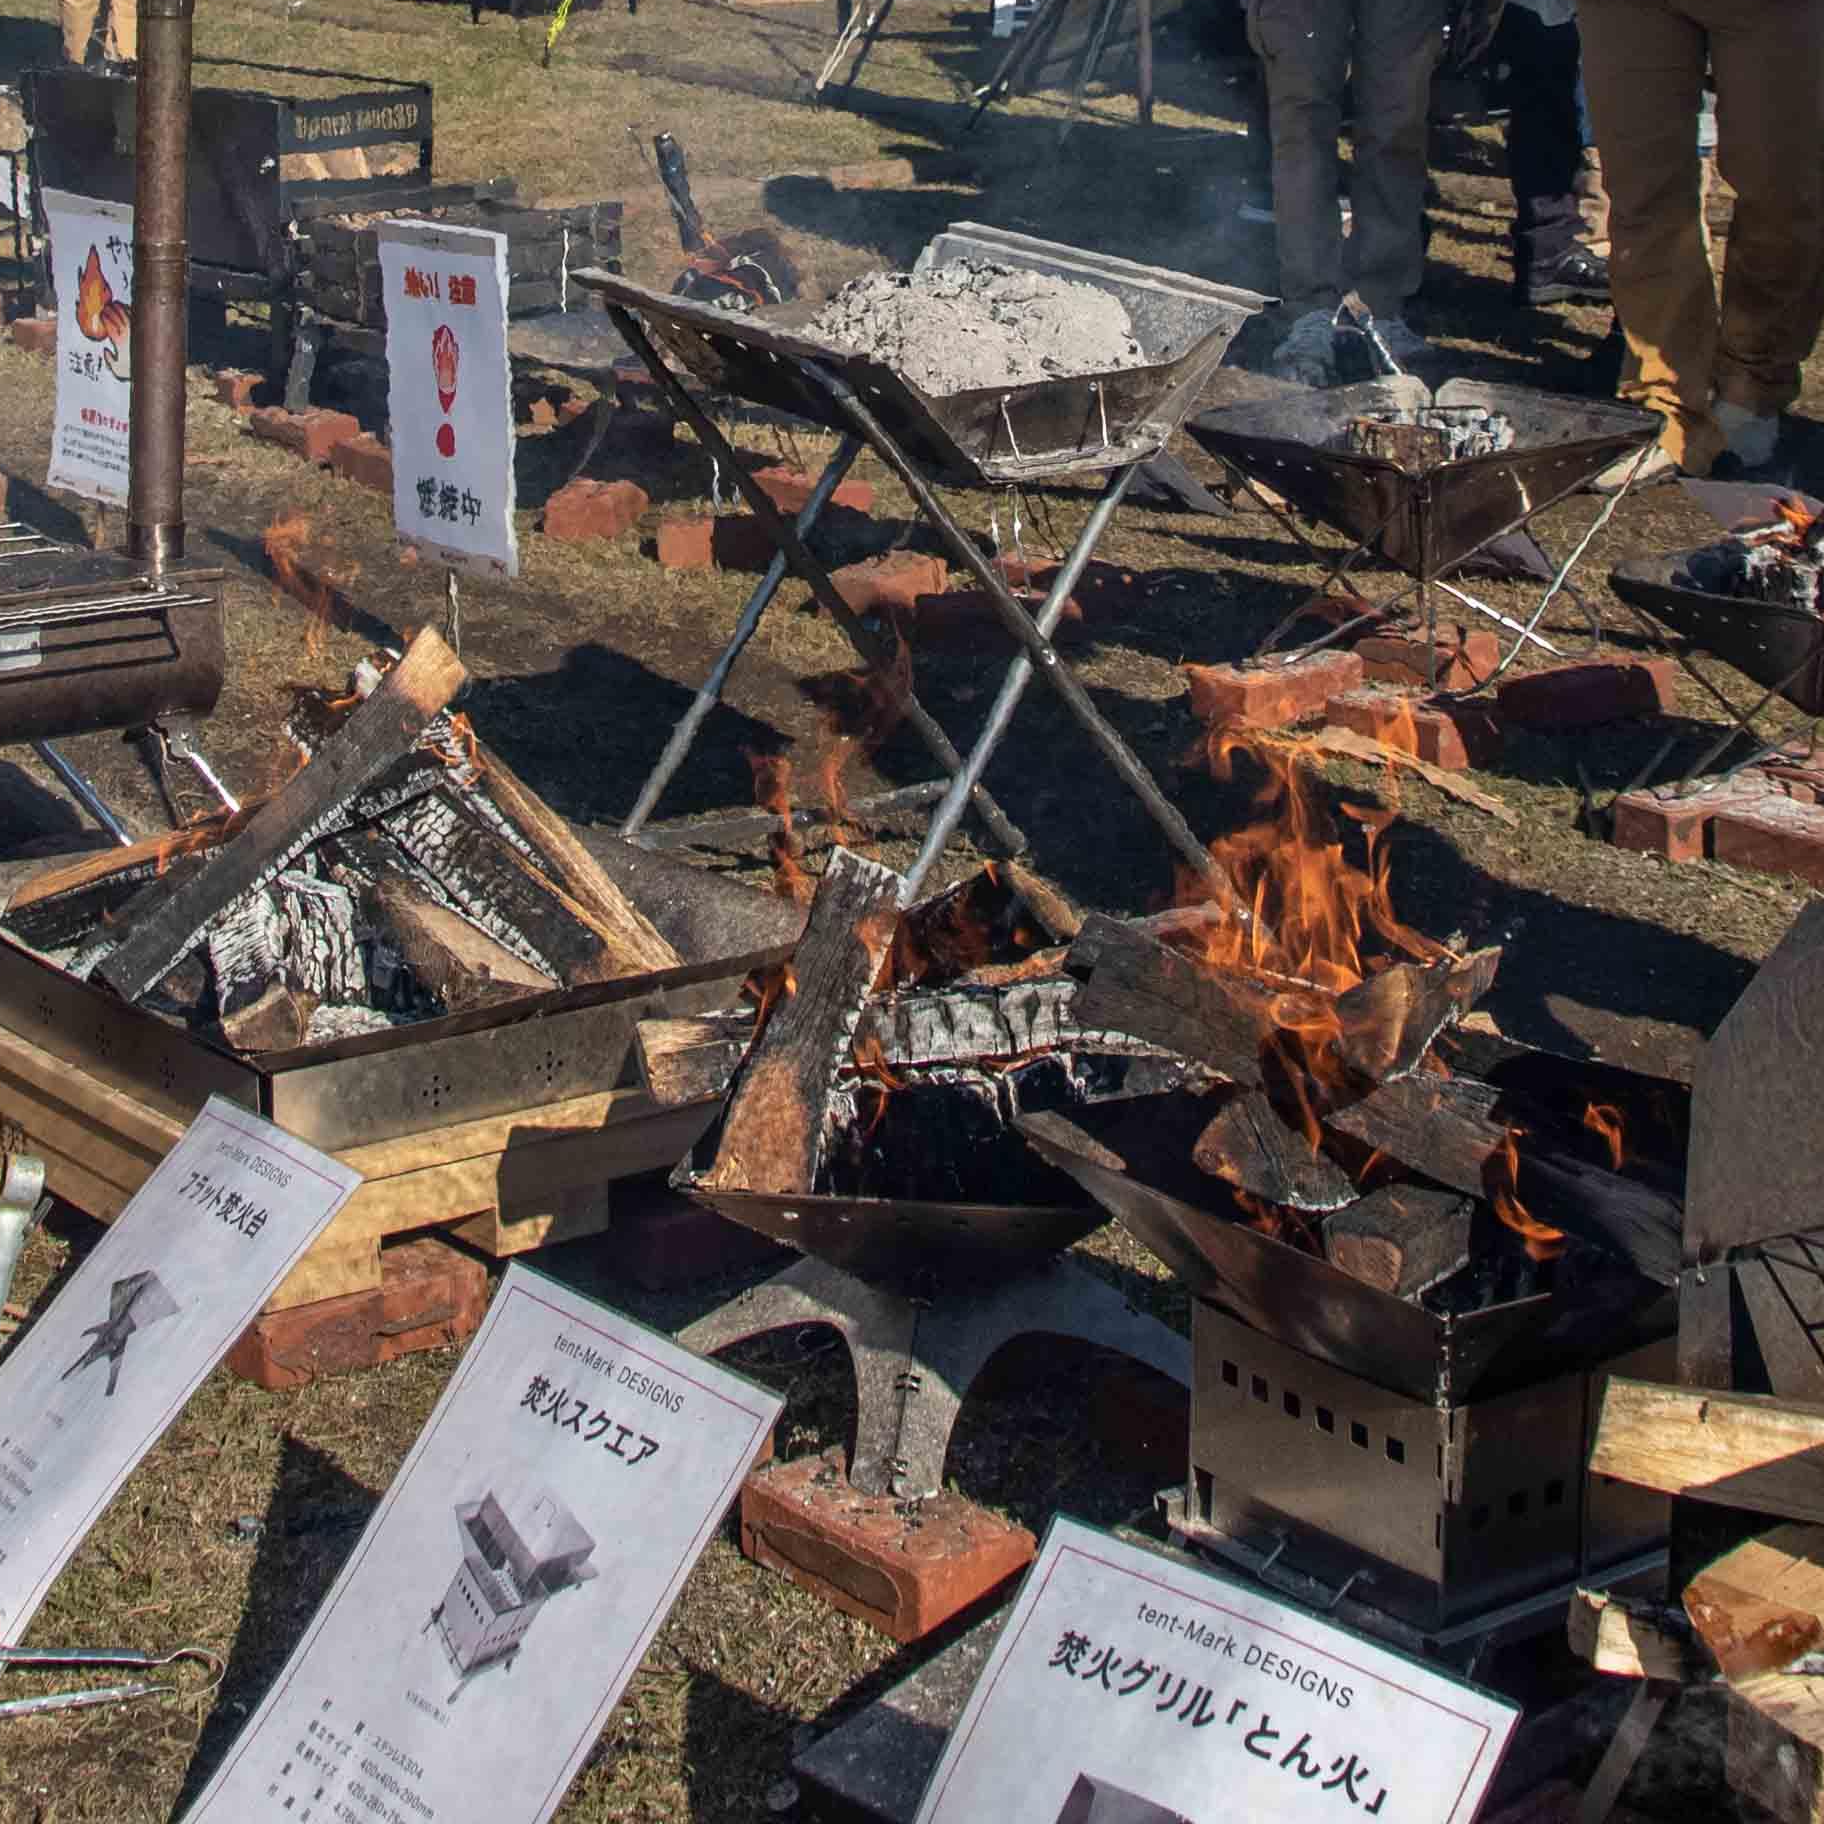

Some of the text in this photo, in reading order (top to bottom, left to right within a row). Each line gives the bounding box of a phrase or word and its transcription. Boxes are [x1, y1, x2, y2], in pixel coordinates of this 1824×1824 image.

[178, 1170, 268, 1239] フラット焚火台
[249, 1155, 292, 1188] DESIGNS
[554, 1333, 685, 1414] tent-Mark DESIGNS
[520, 1373, 660, 1466] 焚火スクエア
[1137, 1602, 1354, 1709] tent-Mark DESIGNS
[1048, 1630, 1388, 1816] 焚火グリル「とん火」
